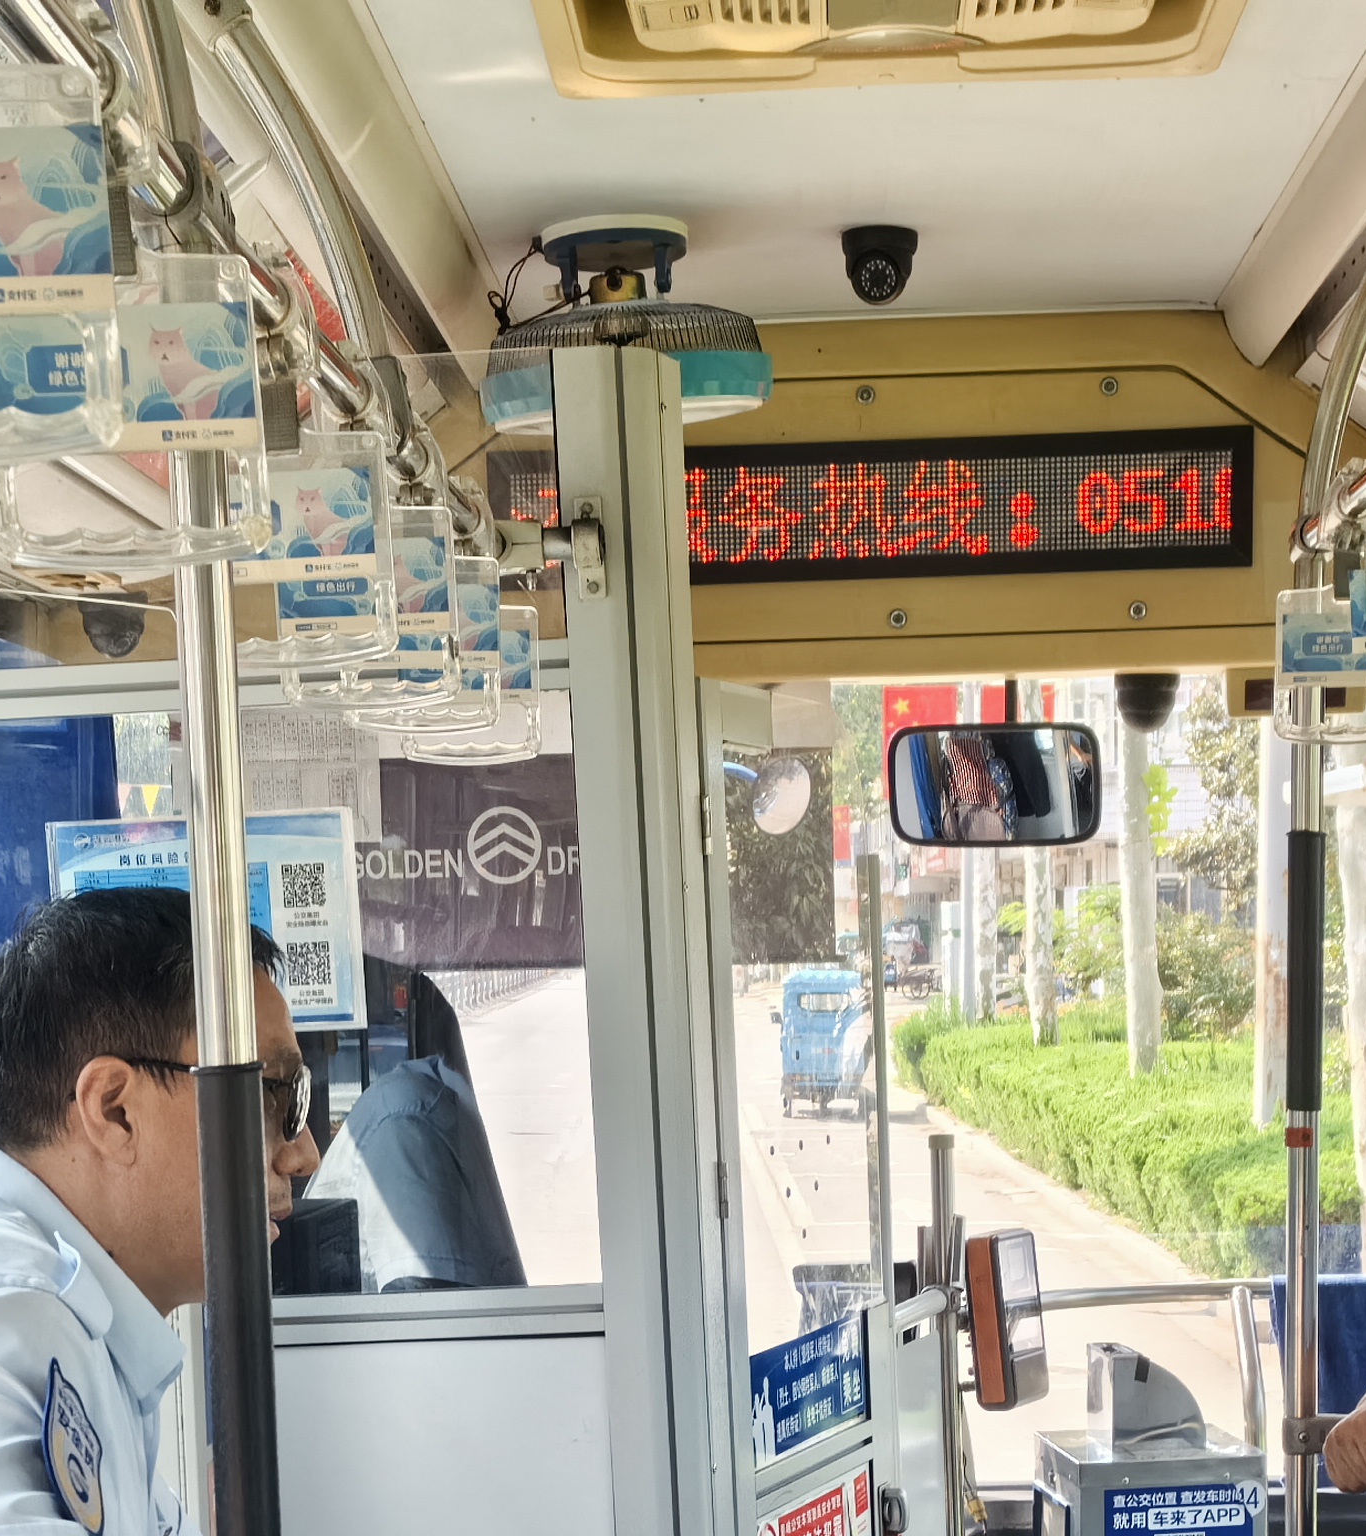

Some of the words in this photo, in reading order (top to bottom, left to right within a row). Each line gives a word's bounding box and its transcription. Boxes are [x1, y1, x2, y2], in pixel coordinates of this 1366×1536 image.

[54, 352, 85, 368] 谢谢
[315, 581, 357, 594] 绿色出行
[842, 1369, 861, 1406] 乘坐
[1113, 1492, 1177, 1508] 查公交位置
[1112, 1512, 1146, 1530] 就用
[1152, 1507, 1240, 1527] 车来了APP
